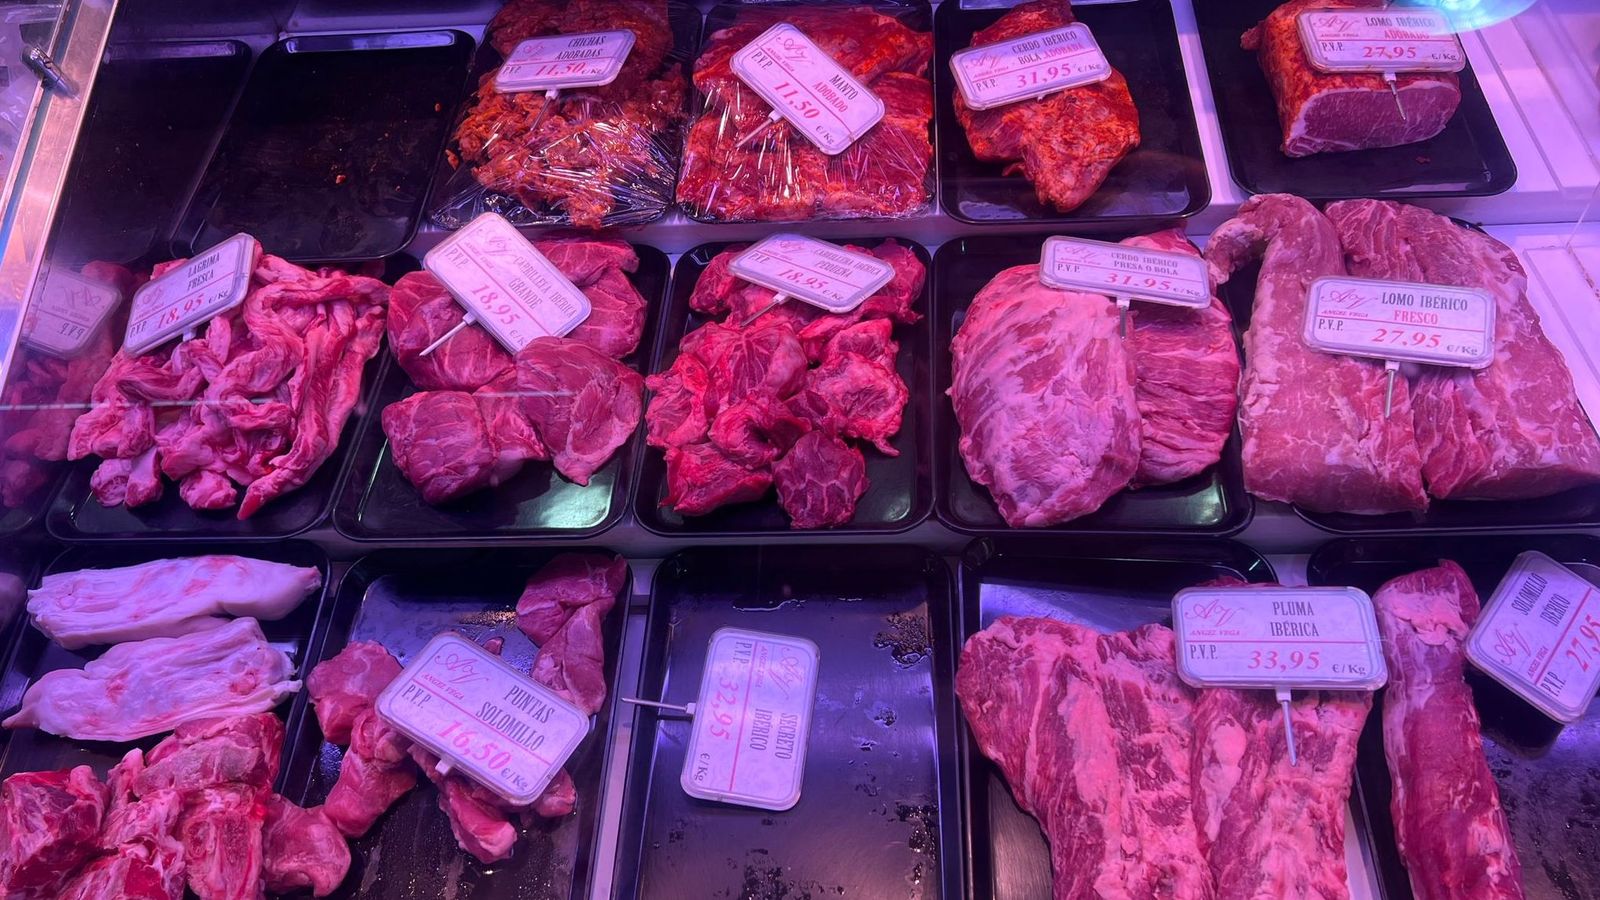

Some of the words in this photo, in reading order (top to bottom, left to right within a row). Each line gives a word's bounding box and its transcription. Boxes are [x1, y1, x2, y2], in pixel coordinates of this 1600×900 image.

[1365, 17, 1392, 28] LOMO
[568, 36, 606, 48] CHICHAS
[1012, 41, 1041, 54] CERDO
[1042, 31, 1077, 46] IBÉRICO
[555, 50, 602, 61] ADOBADAS
[1018, 54, 1042, 65] BOLA
[536, 62, 586, 76] 11,50
[1017, 63, 1071, 88] 31,95
[813, 81, 849, 113] ADOBADO
[829, 74, 858, 100] MANTO
[773, 81, 820, 119] 11,50
[1111, 252, 1139, 262] CERDO
[1142, 256, 1178, 268] IBÉRICO
[1114, 260, 1143, 271] PRESA
[1154, 266, 1178, 276] BOLA
[188, 270, 214, 292] FRESCA
[509, 278, 542, 309] GRANDE
[1382, 292, 1414, 306] LOMO
[1420, 295, 1468, 311] IBÉRICO
[472, 284, 520, 325] 18,95
[509, 330, 527, 346] €/K
[1318, 319, 1344, 331] P.V.P.
[1394, 310, 1438, 325] FRESCO
[1511, 573, 1548, 616] SOLOMILLO
[1272, 601, 1314, 616] PLUMA
[1540, 593, 1571, 627] IBÉRICO
[1270, 620, 1319, 637] IBÉRICA
[1190, 644, 1218, 660] P.V.P.
[1247, 650, 1320, 673] 33,95
[1541, 671, 1566, 697] P.V.P.
[504, 684, 555, 724] PUNTAS
[709, 677, 739, 741] 32,95
[401, 684, 431, 709] P.V.P.
[437, 720, 513, 770] 16,50
[476, 701, 545, 751] SOLOMILLO
[750, 708, 774, 751] IBÉRICO
[775, 713, 799, 760] SECRETO
